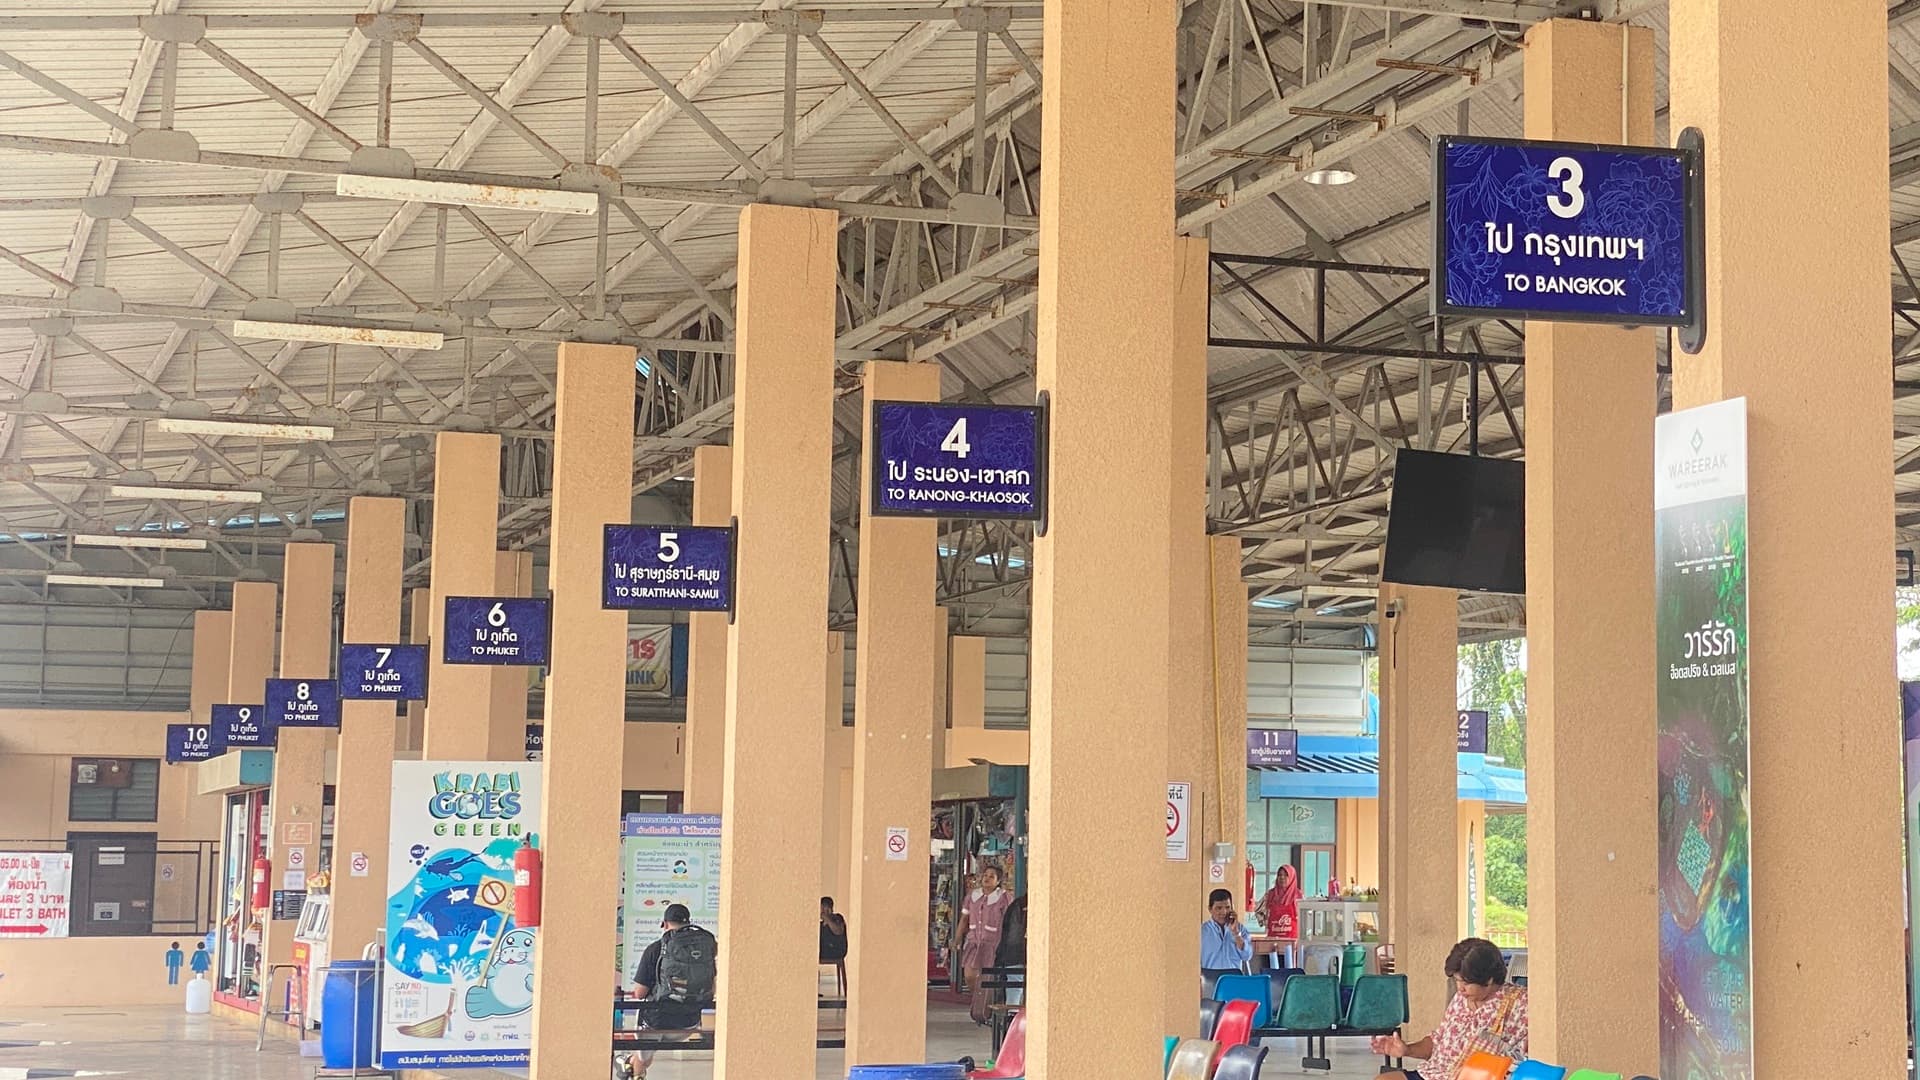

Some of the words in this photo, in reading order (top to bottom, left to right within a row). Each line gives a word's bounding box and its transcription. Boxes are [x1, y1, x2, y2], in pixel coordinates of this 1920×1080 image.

[1546, 157, 1584, 218] 3
[1485, 222, 1513, 253] ไป
[1524, 233, 1644, 265] กรุงเทพฯ
[1505, 274, 1530, 292] TO
[1536, 276, 1626, 296] BANGKOK
[941, 417, 970, 458] 4
[888, 460, 906, 481] ไป
[914, 466, 1029, 485] ระนอง-เขาสก
[1668, 454, 1728, 480] WAREERAK
[888, 488, 905, 500] TO
[909, 489, 1030, 504] RANONG-KHAOSOK
[657, 532, 680, 562] 5
[614, 563, 626, 579] ไป
[630, 565, 719, 585] สุราษฎร์ธานี-สมุย
[615, 587, 628, 597] TO
[631, 587, 719, 599] SURATTHANI-SAMUI
[488, 602, 506, 627] 6
[476, 628, 487, 641] ไป
[490, 628, 517, 645] ภูเก็ต
[1684, 620, 1735, 658] วารีรัก
[376, 648, 391, 668] 7
[471, 646, 485, 655] TO
[487, 647, 520, 656] PHUKET
[364, 670, 374, 681] ไป
[377, 669, 400, 683] ภูเก็ต
[1702, 663, 1709, 677] &
[297, 683, 309, 700] 8
[374, 685, 402, 693] PHUKET
[239, 708, 251, 723] 9
[287, 701, 296, 711] ไป
[298, 700, 318, 714] ภูเก็ต
[230, 724, 238, 732] ไป
[240, 723, 258, 735] ภูเก็ต
[1459, 713, 1469, 729] 2
[187, 728, 207, 742] 10
[1263, 732, 1279, 746] 11
[433, 771, 522, 794] KRABI
[429, 791, 522, 819] GOES
[434, 823, 522, 836] GREEN
[8, 872, 48, 890] ห้องน้ำ
[0, 894, 21, 904] นละ
[26, 893, 34, 904] 3
[41, 894, 64, 904] บาท
[0, 908, 22, 919] ILET
[26, 908, 33, 919] 3
[38, 908, 66, 919] BATH
[1706, 991, 1743, 1009] WATER
